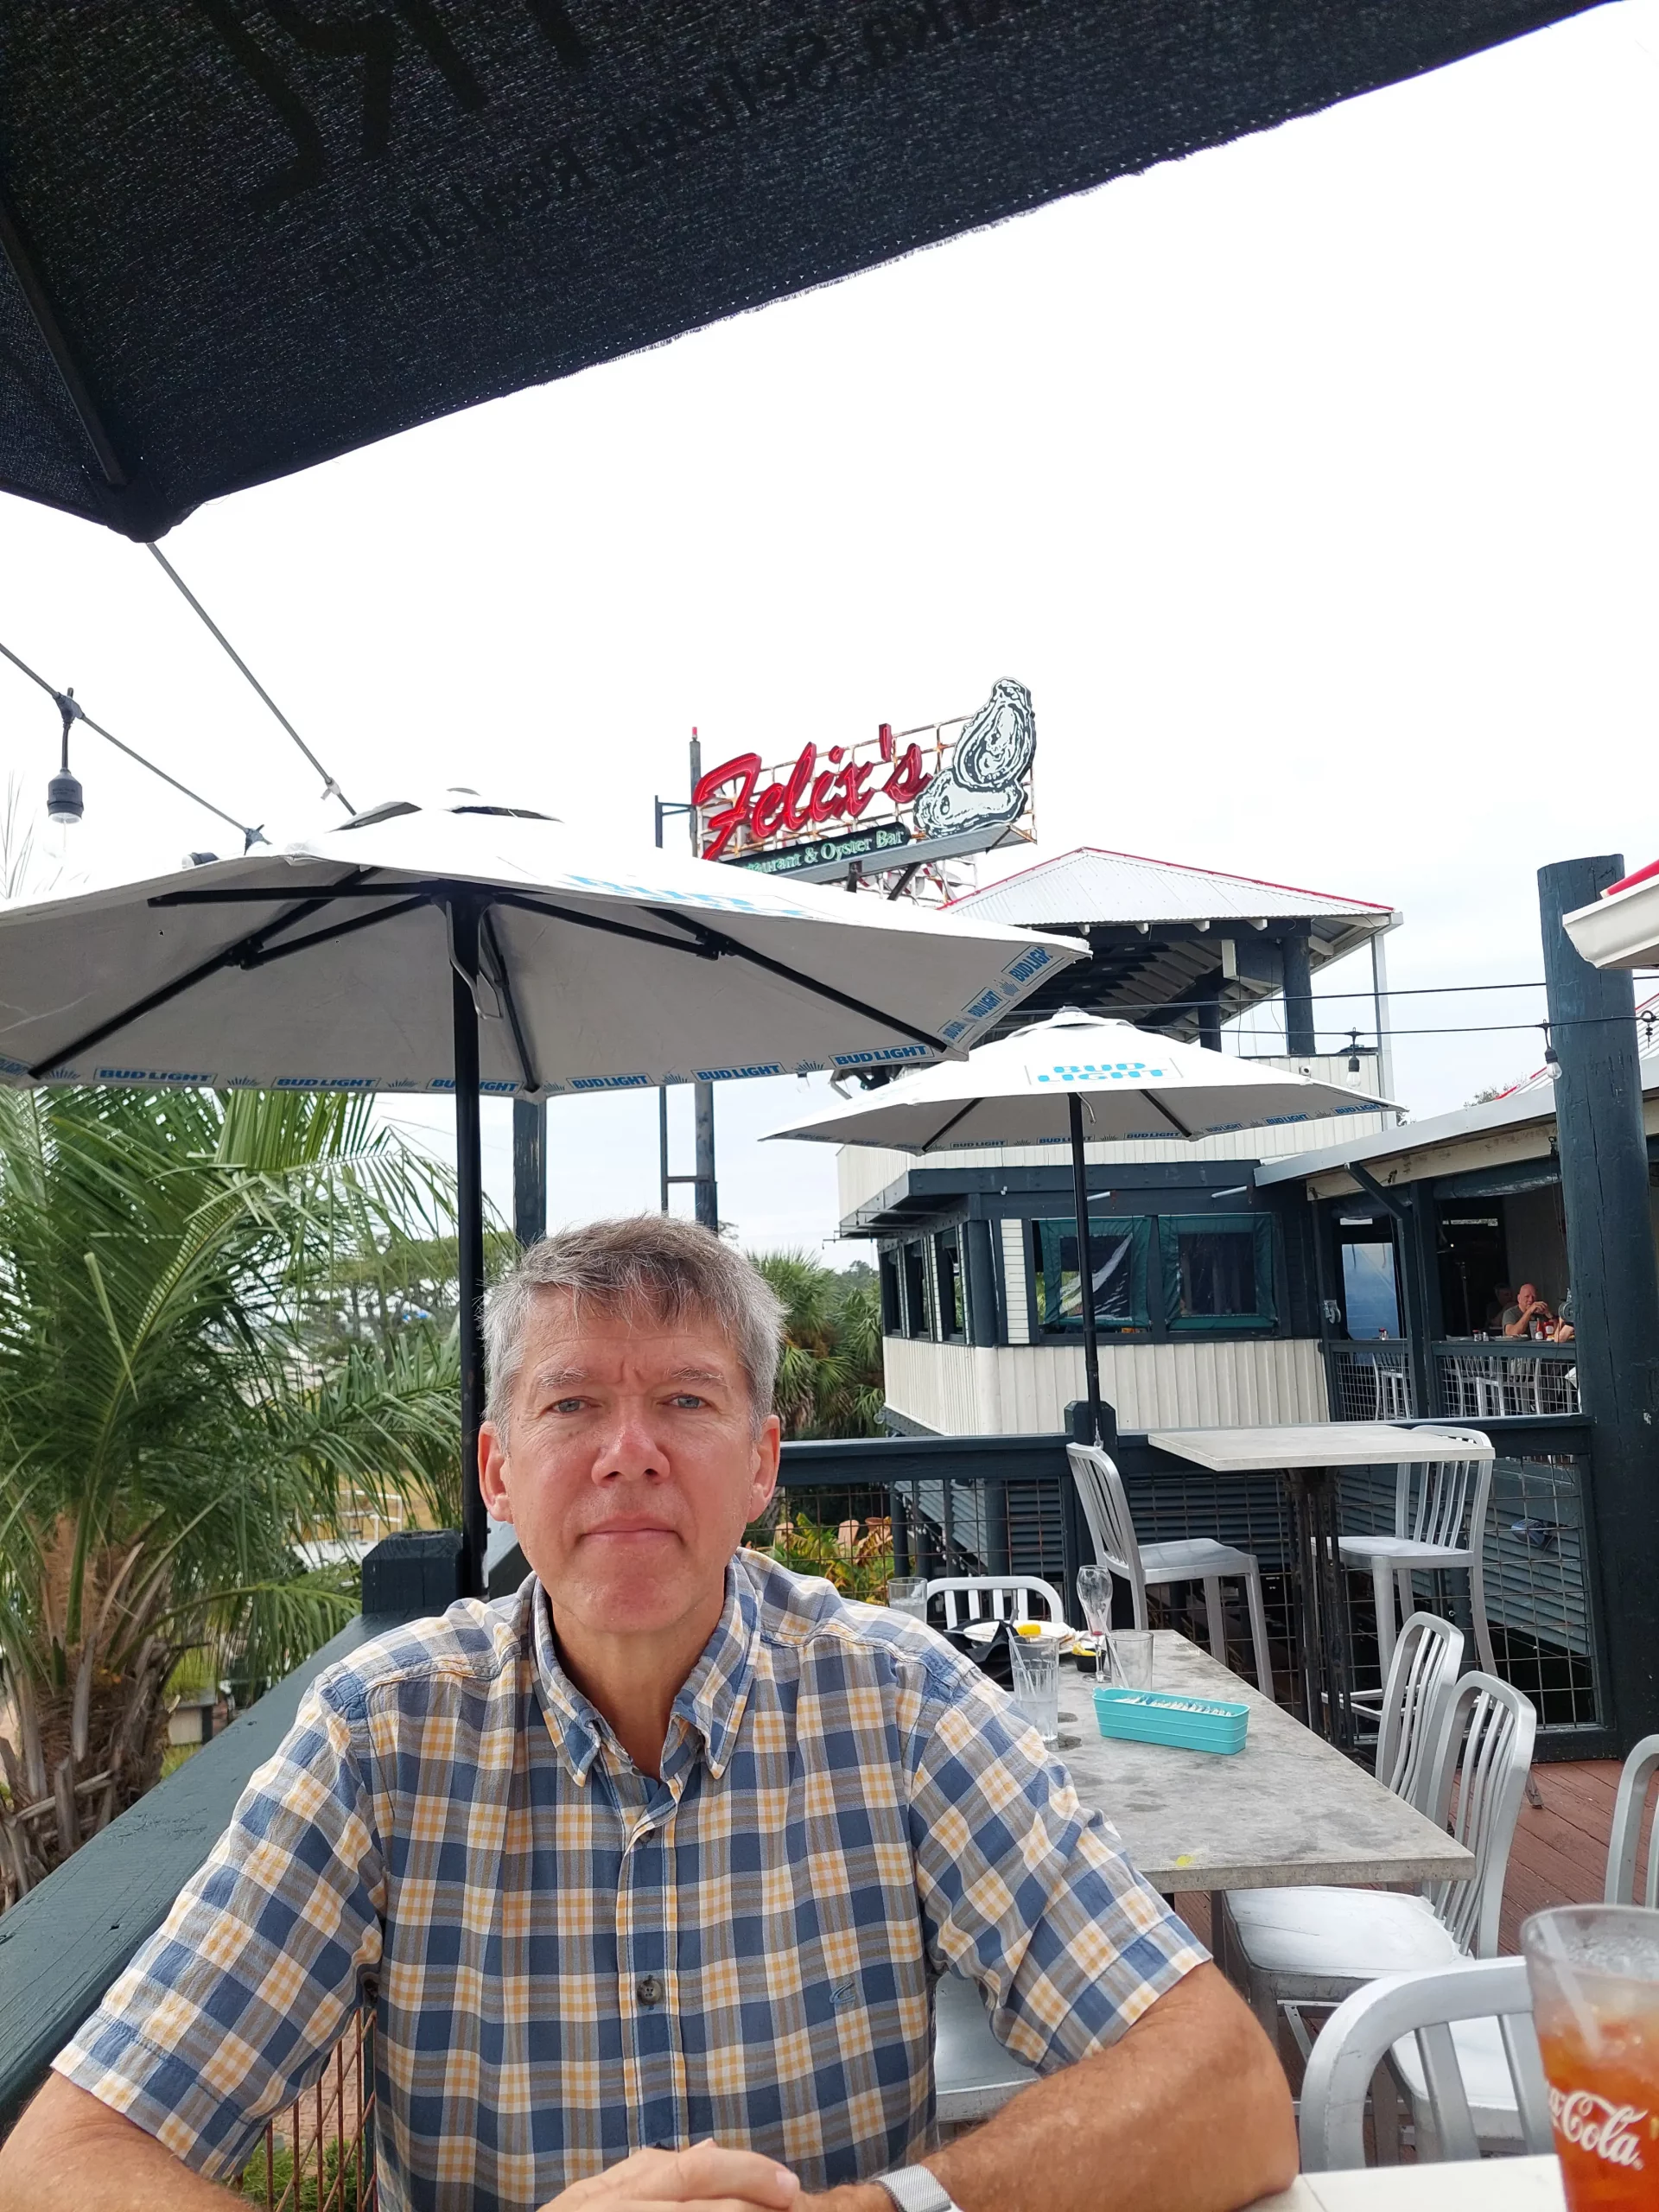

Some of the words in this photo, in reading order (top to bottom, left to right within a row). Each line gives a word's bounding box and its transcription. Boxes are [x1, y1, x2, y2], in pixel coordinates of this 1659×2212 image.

[692, 723, 933, 861] Felix's
[804, 847, 820, 864] &
[821, 838, 874, 862] Oyster
[875, 830, 905, 849] Bar
[835, 1052, 874, 1065] BUD
[873, 1046, 928, 1060] LIGHT
[99, 1070, 147, 1079] BUD
[149, 1071, 213, 1082] LIGHT
[696, 1070, 733, 1081] BUD
[732, 1065, 780, 1078] LIGHT
[431, 1079, 456, 1088] BU
[479, 1081, 519, 1092] IGHT
[572, 1078, 605, 1089] BUD
[604, 1075, 648, 1087] LIGHT
[1334, 1106, 1358, 1115] BUD
[1266, 1117, 1286, 1126] BUD
[1284, 1113, 1309, 1122] LIGHT
